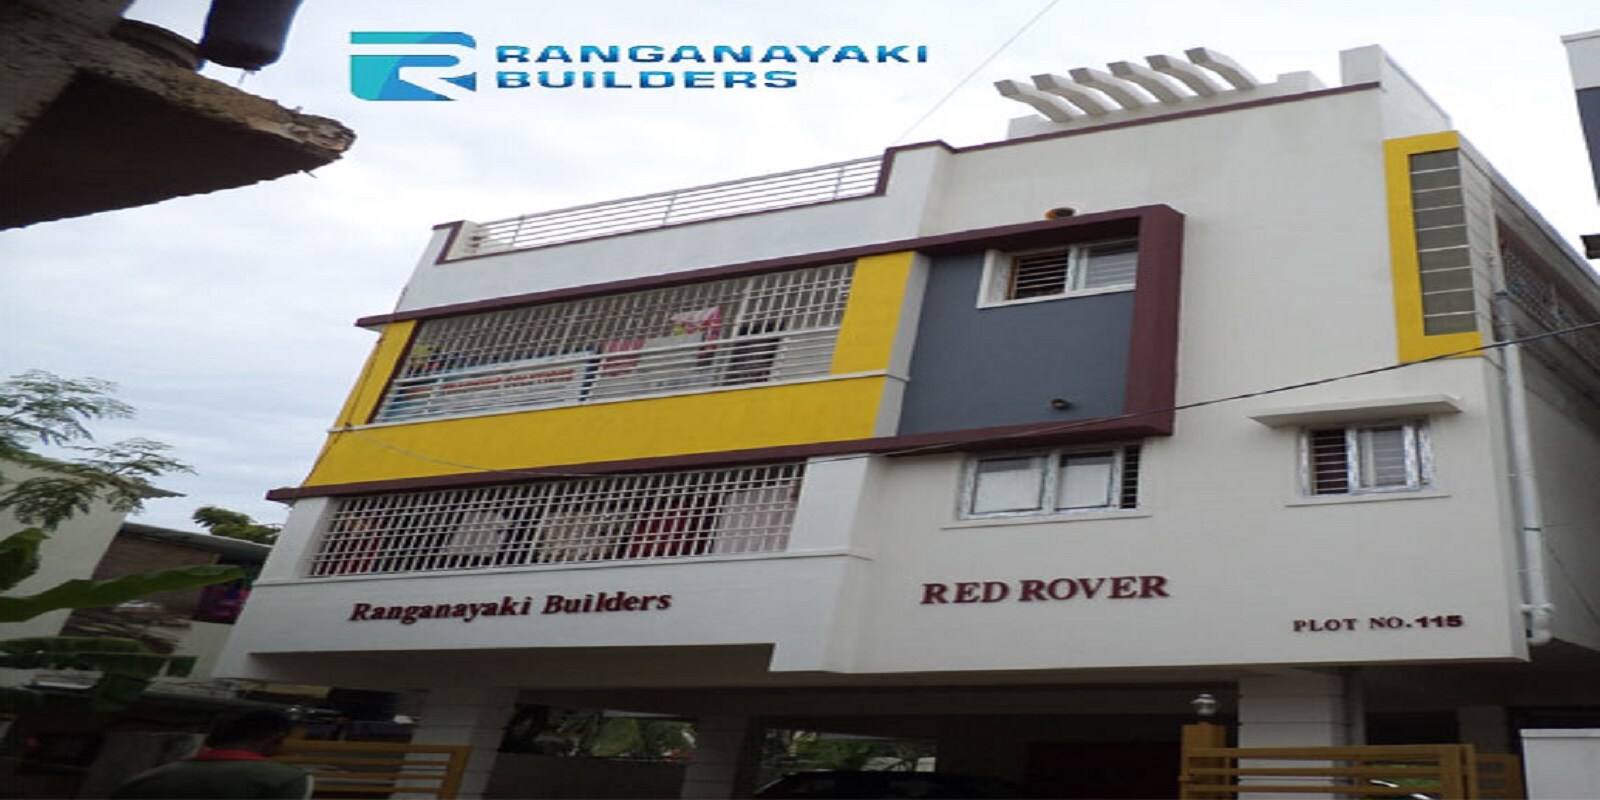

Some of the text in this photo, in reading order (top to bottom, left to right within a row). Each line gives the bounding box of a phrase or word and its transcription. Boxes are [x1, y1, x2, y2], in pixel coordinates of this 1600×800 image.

[921, 575, 1169, 606] RED ROVER
[349, 591, 673, 624] Ranganayaki Builders
[1293, 619, 1357, 632] PLOT
